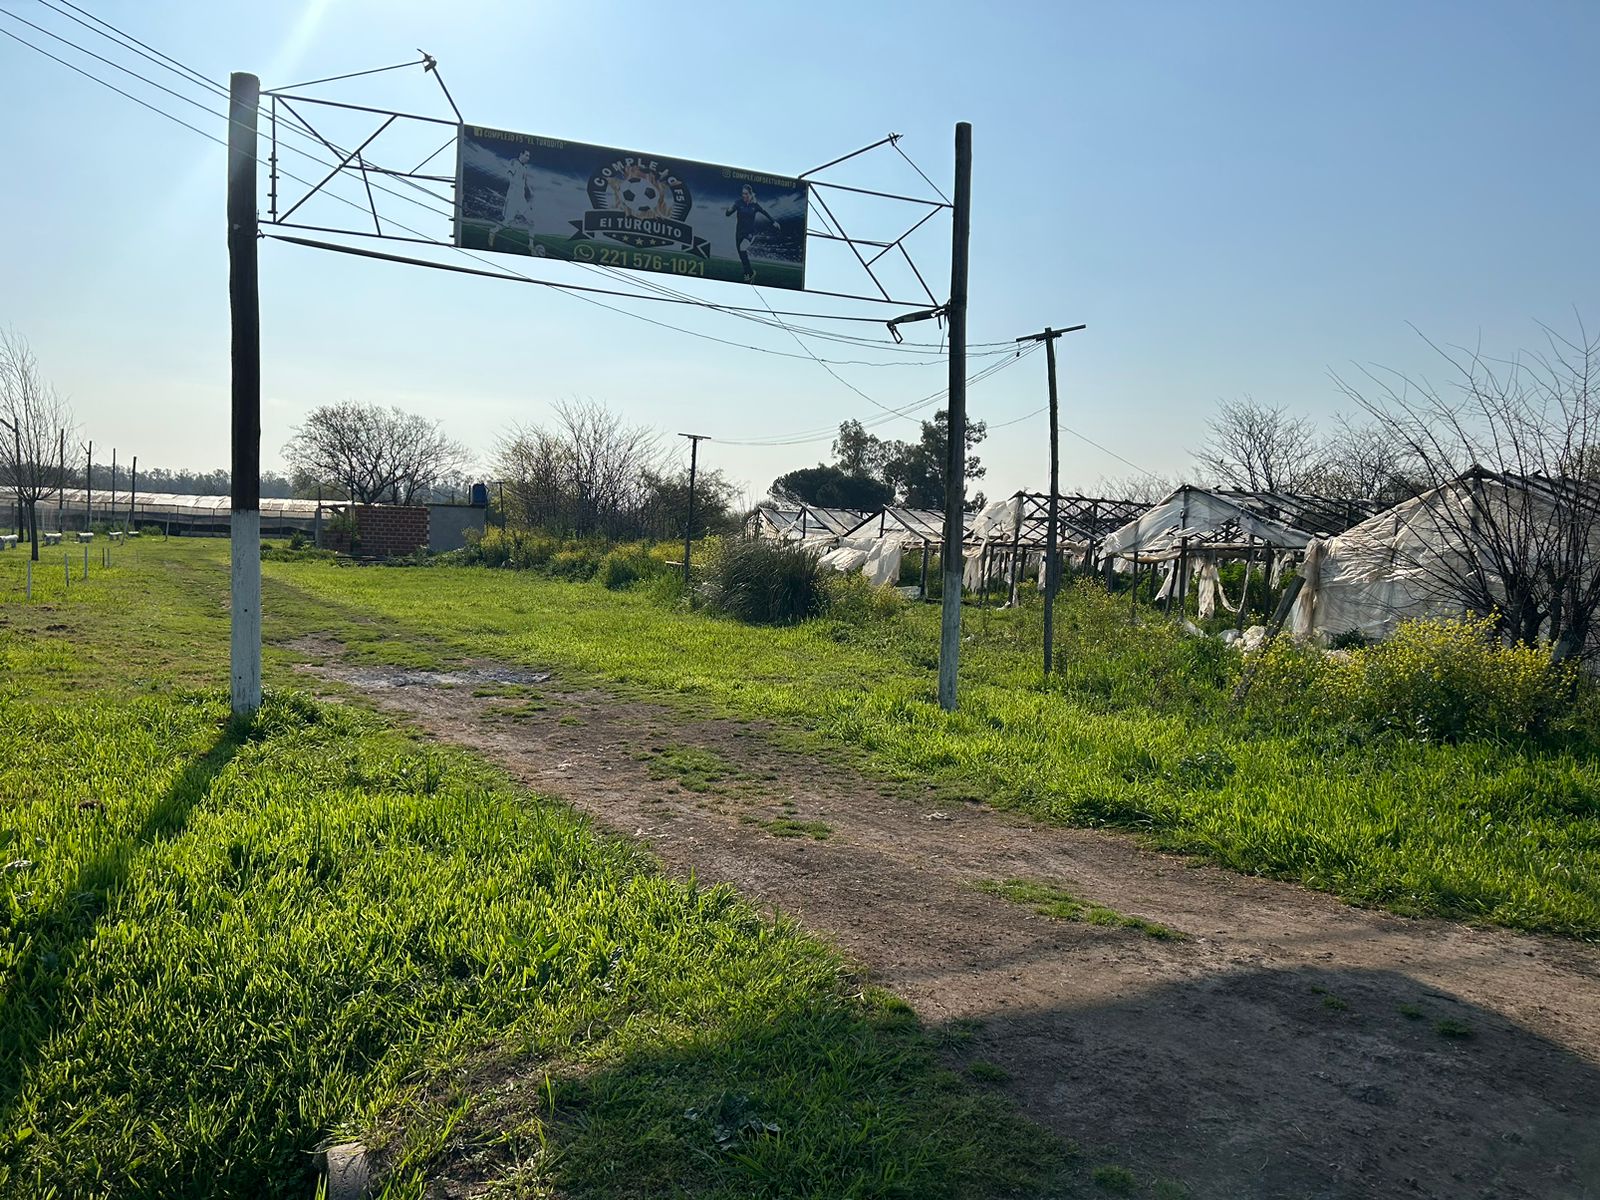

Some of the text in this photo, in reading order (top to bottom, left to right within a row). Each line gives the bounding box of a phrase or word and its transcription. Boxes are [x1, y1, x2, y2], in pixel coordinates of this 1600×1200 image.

[484, 129, 515, 142] COMPLEJO
[594, 158, 685, 202] COMPLEJO F5
[616, 218, 682, 238] TURQUITO
[600, 249, 705, 276] 221 576-1021
